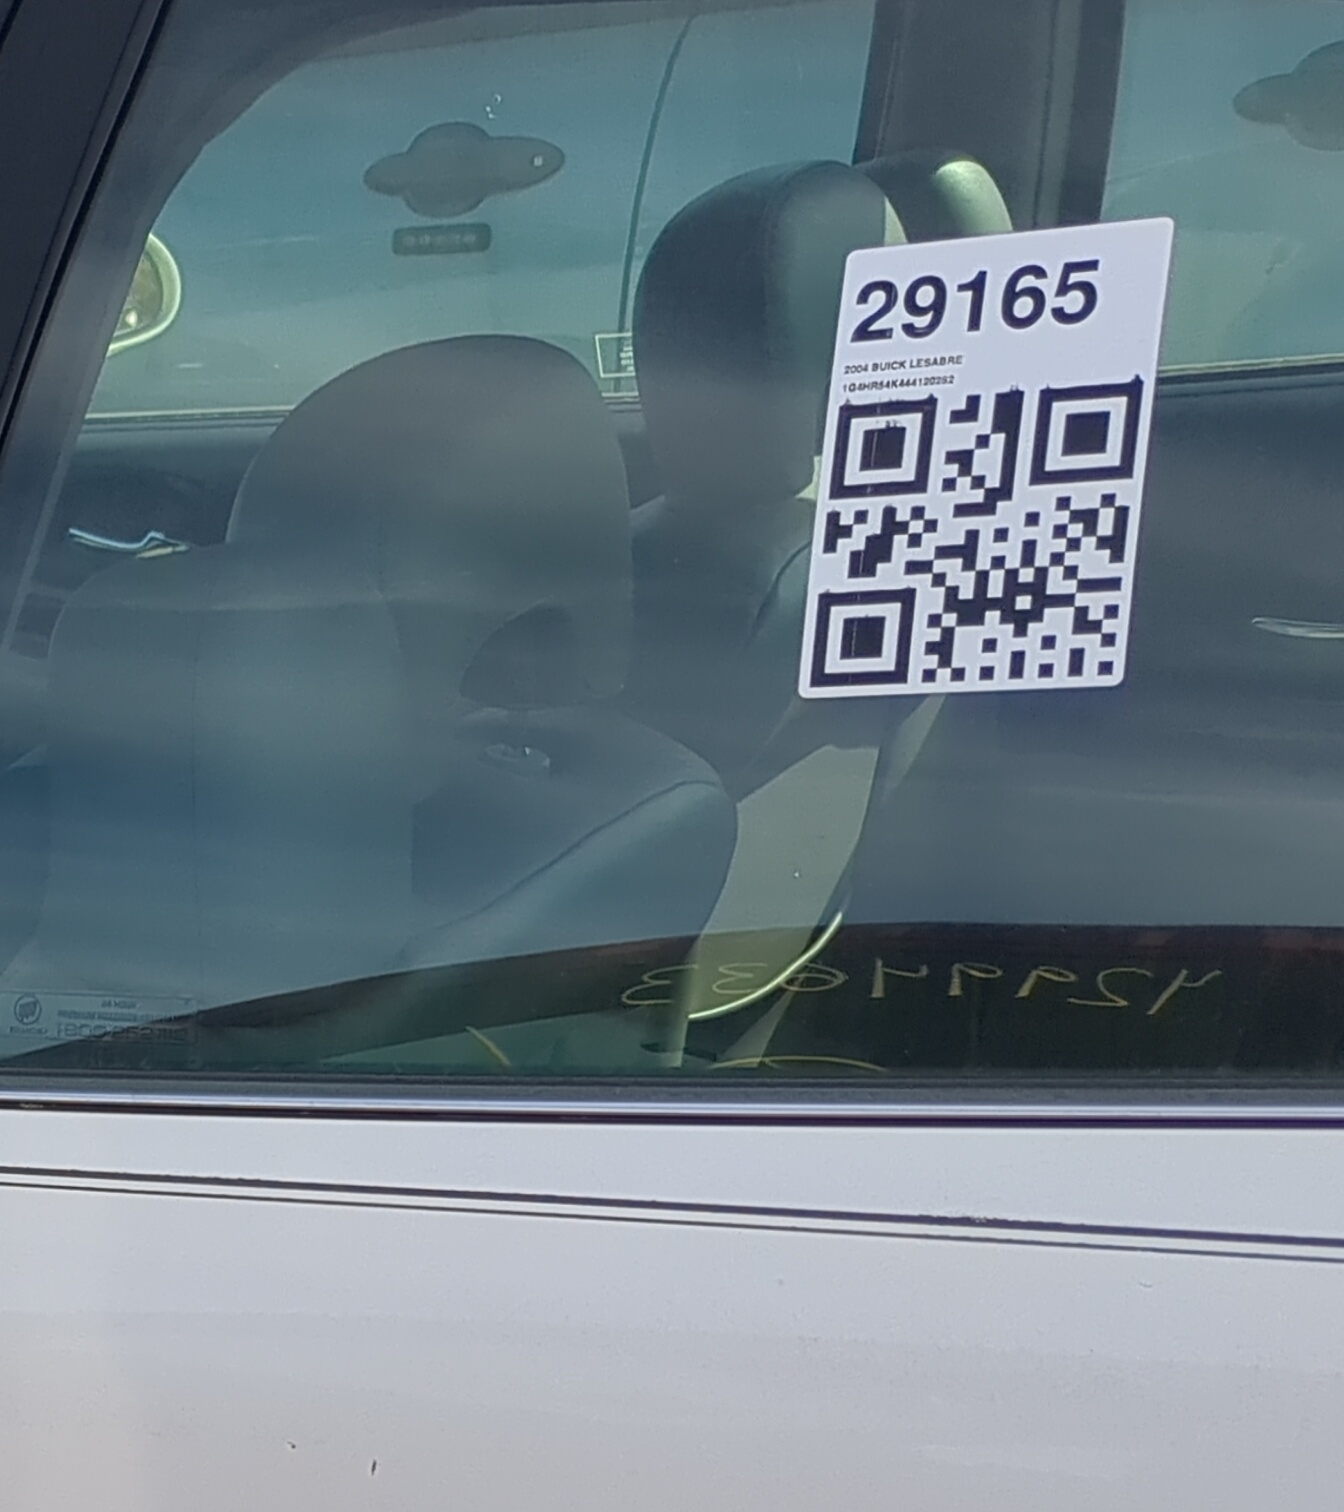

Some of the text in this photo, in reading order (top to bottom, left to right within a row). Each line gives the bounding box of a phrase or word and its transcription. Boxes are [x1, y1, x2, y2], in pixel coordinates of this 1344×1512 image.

[850, 259, 1100, 343] 29165
[843, 355, 963, 374] 2004 BUICK LESABRE
